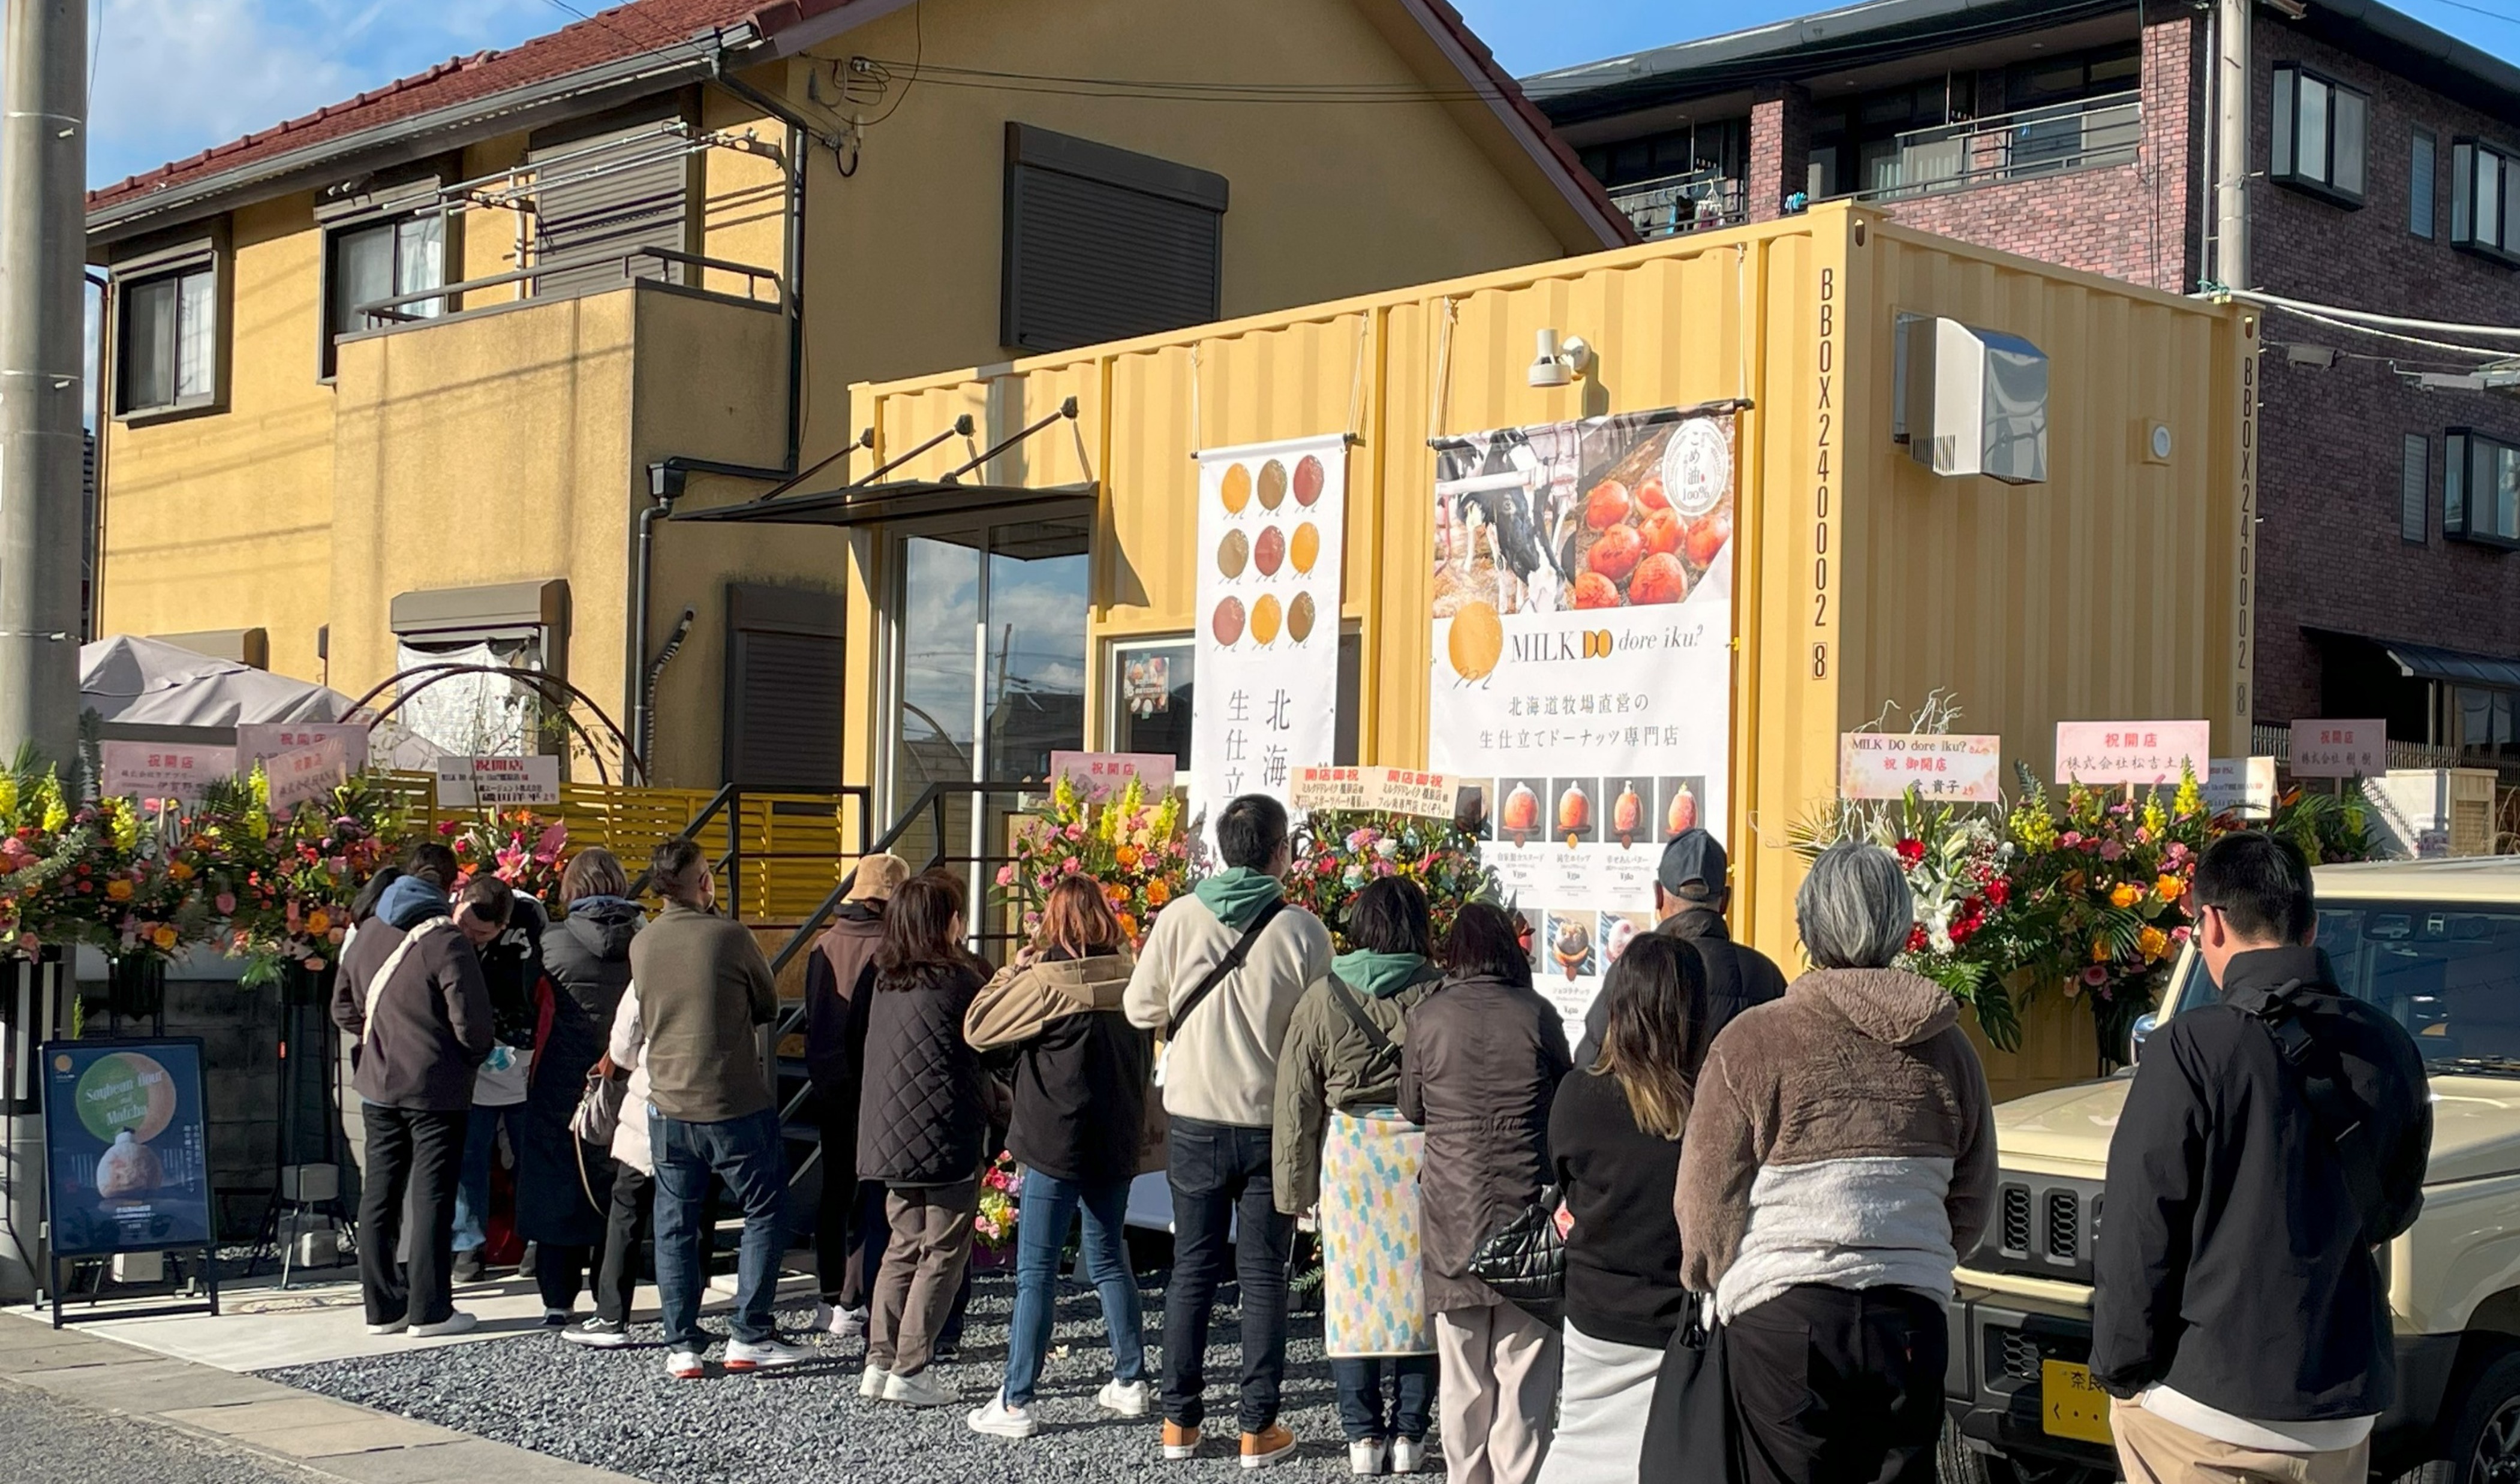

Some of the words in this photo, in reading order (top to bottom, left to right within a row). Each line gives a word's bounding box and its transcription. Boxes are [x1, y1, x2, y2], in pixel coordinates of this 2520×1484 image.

[1814, 268, 1833, 626] BBOX240002
[1688, 431, 1701, 485] こめ油
[1683, 486, 1710, 501] 100%
[2238, 357, 2253, 669] BBOX240002
[1510, 631, 1576, 663] MILK
[1580, 629, 1613, 659] DO
[1619, 631, 1657, 651] dore
[1664, 624, 1703, 648] iku?
[1814, 645, 1826, 678] 8
[1509, 693, 1649, 716] 北海道牧場直営の
[1479, 725, 1679, 749] 生仕立てドーナッツ専門店
[1853, 739, 1882, 750] MILK
[1889, 740, 1905, 750] DO
[1911, 741, 1935, 751] dore
[2105, 733, 2157, 748] 祝開店
[2321, 730, 2354, 744] 祝開店
[148, 754, 194, 769] 祝開店
[475, 759, 524, 772] 祝開店
[1091, 762, 1135, 775] 祝開店
[1884, 757, 1897, 770] 祝
[1906, 757, 1947, 772] 御開店
[1305, 769, 1359, 781] 開店御祝
[1387, 770, 1443, 788] 開店御祝
[85, 1079, 134, 1104] Soybean
[137, 1070, 163, 1088] flour
[106, 1103, 148, 1126] Matcha
[2071, 1371, 2103, 1392] 奈良
